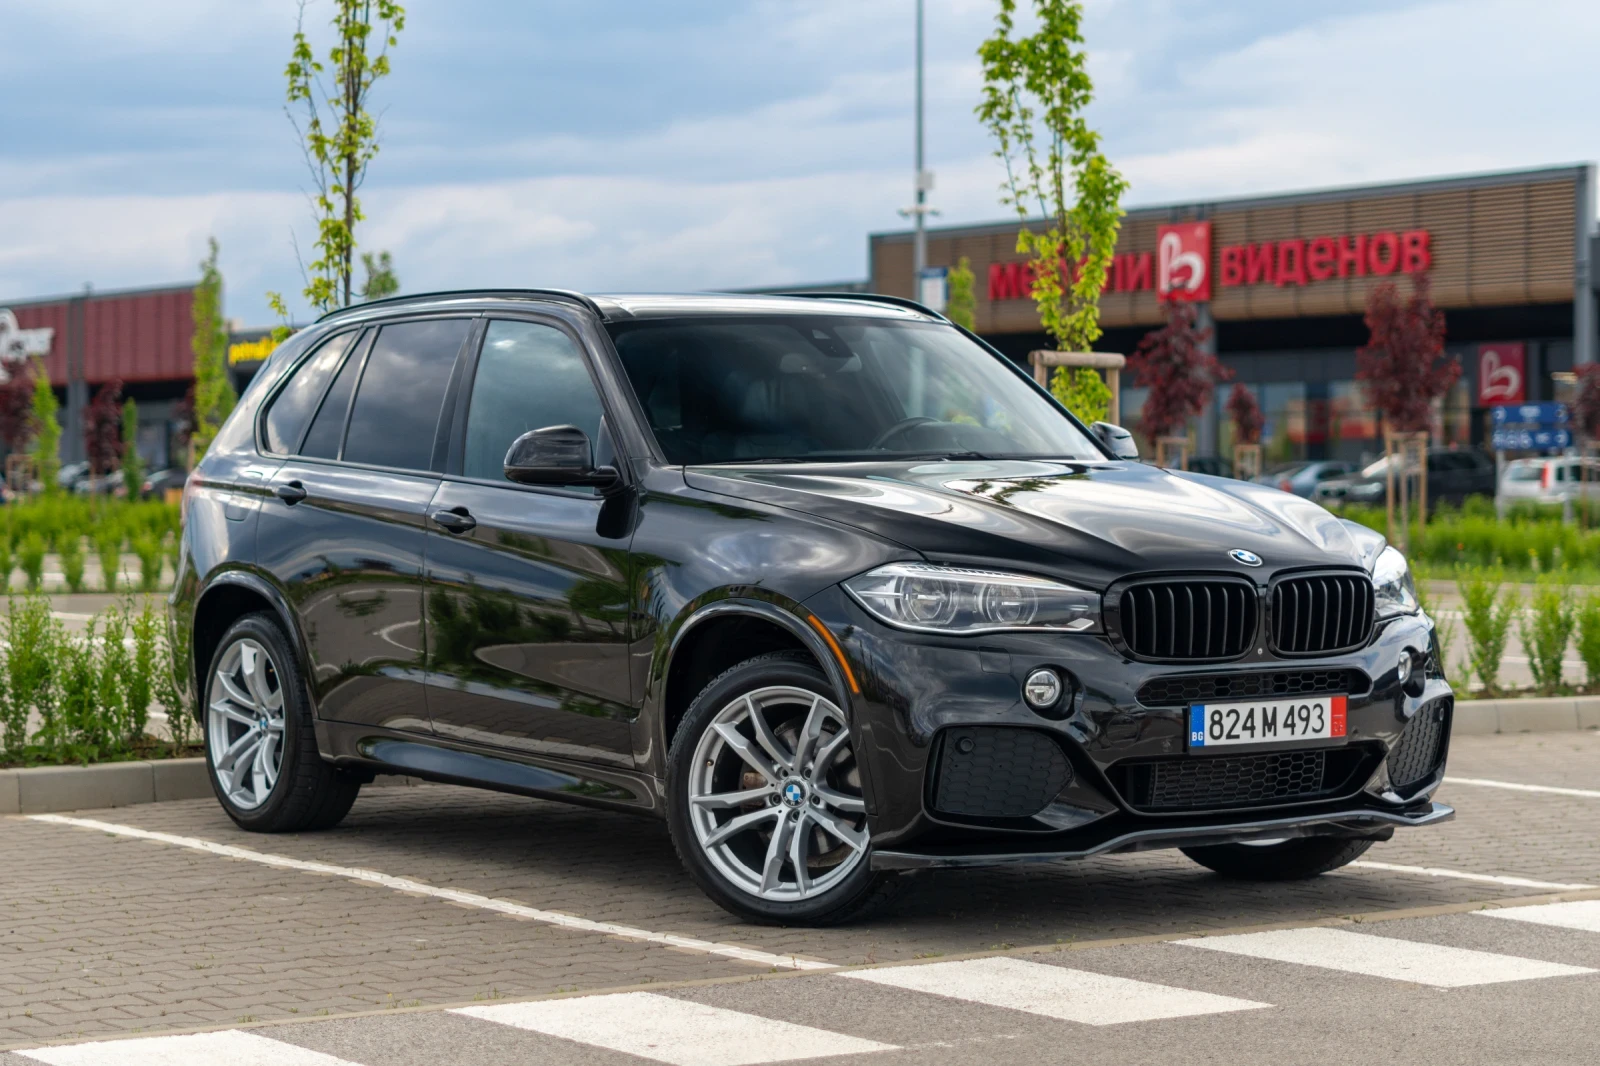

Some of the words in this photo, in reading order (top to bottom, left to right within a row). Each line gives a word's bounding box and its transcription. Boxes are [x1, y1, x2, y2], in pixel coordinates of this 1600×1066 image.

[1191, 731, 1204, 742] BG
[1209, 707, 1256, 741] 824
[1283, 703, 1326, 736] 493
